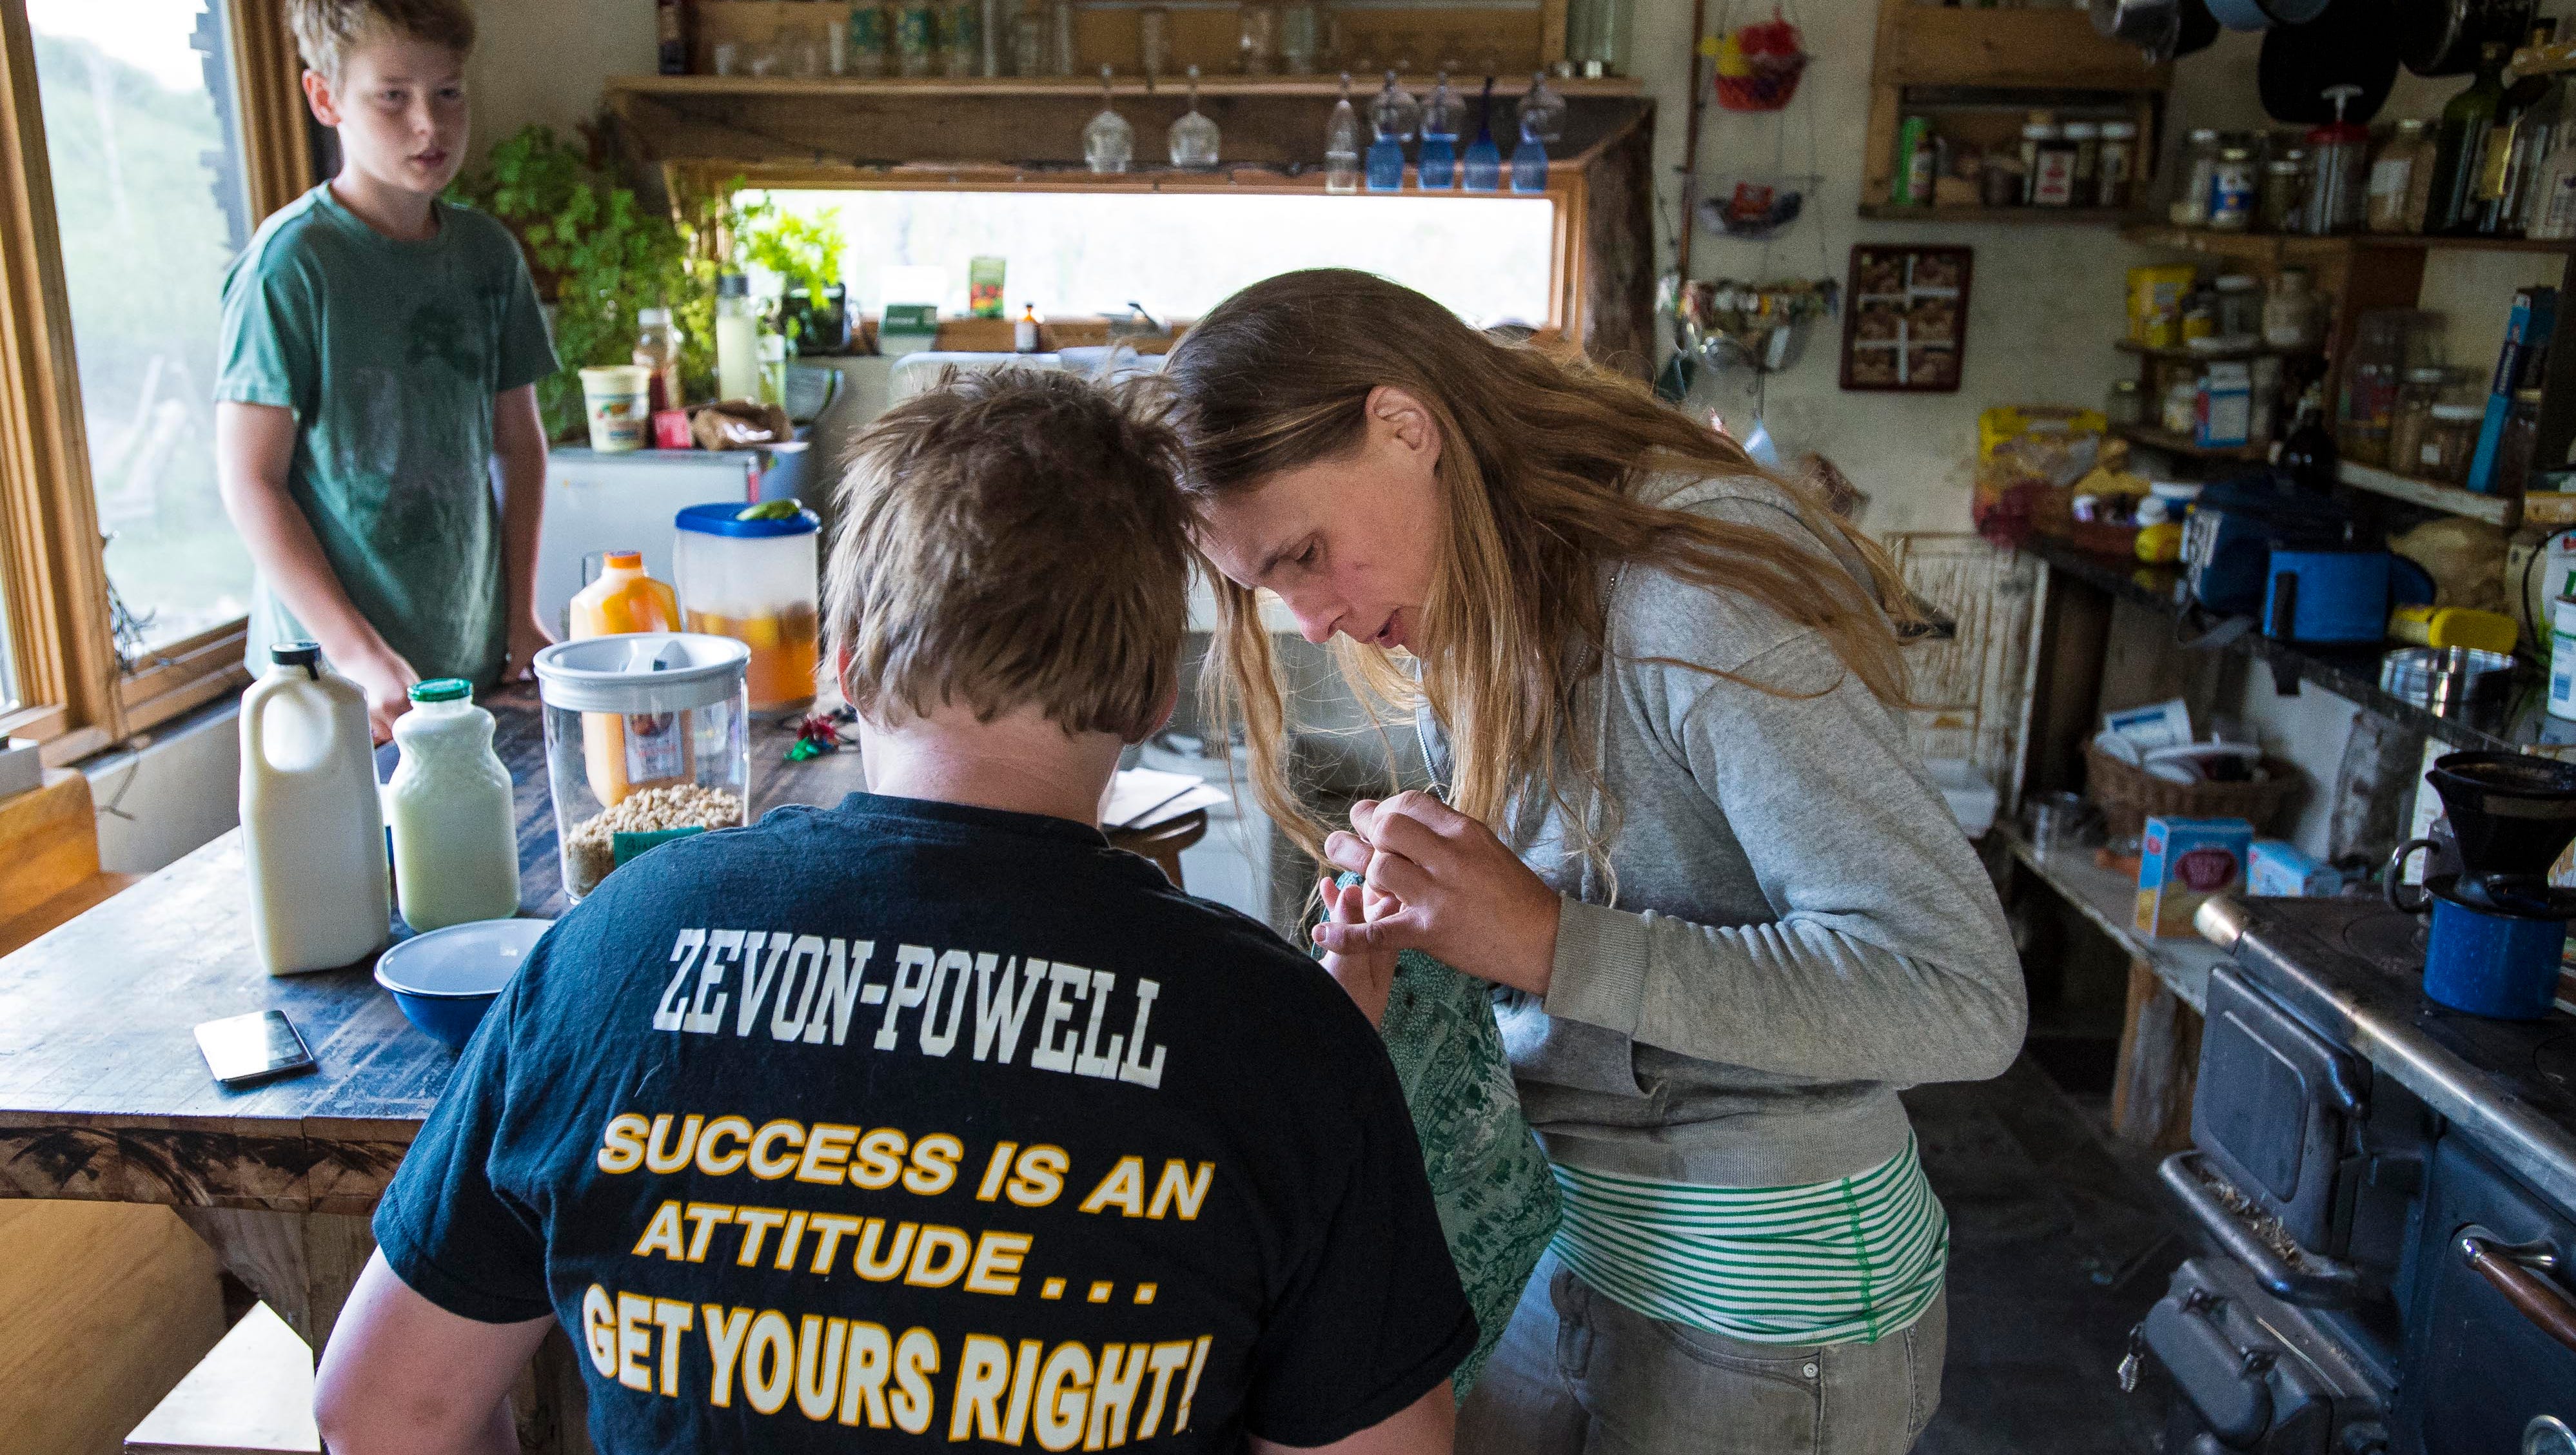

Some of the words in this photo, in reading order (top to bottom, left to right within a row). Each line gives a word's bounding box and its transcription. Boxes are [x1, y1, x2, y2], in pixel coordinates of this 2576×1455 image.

[652, 927, 1168, 1089] ZEVON-POWELL
[596, 1112, 965, 1197] SUCCESS
[976, 1140, 1070, 1207] IS
[1078, 1156, 1216, 1221] AN
[581, 1283, 694, 1398] GET
[700, 1302, 941, 1436] YOURS
[948, 1333, 1214, 1453] RIGHT!
